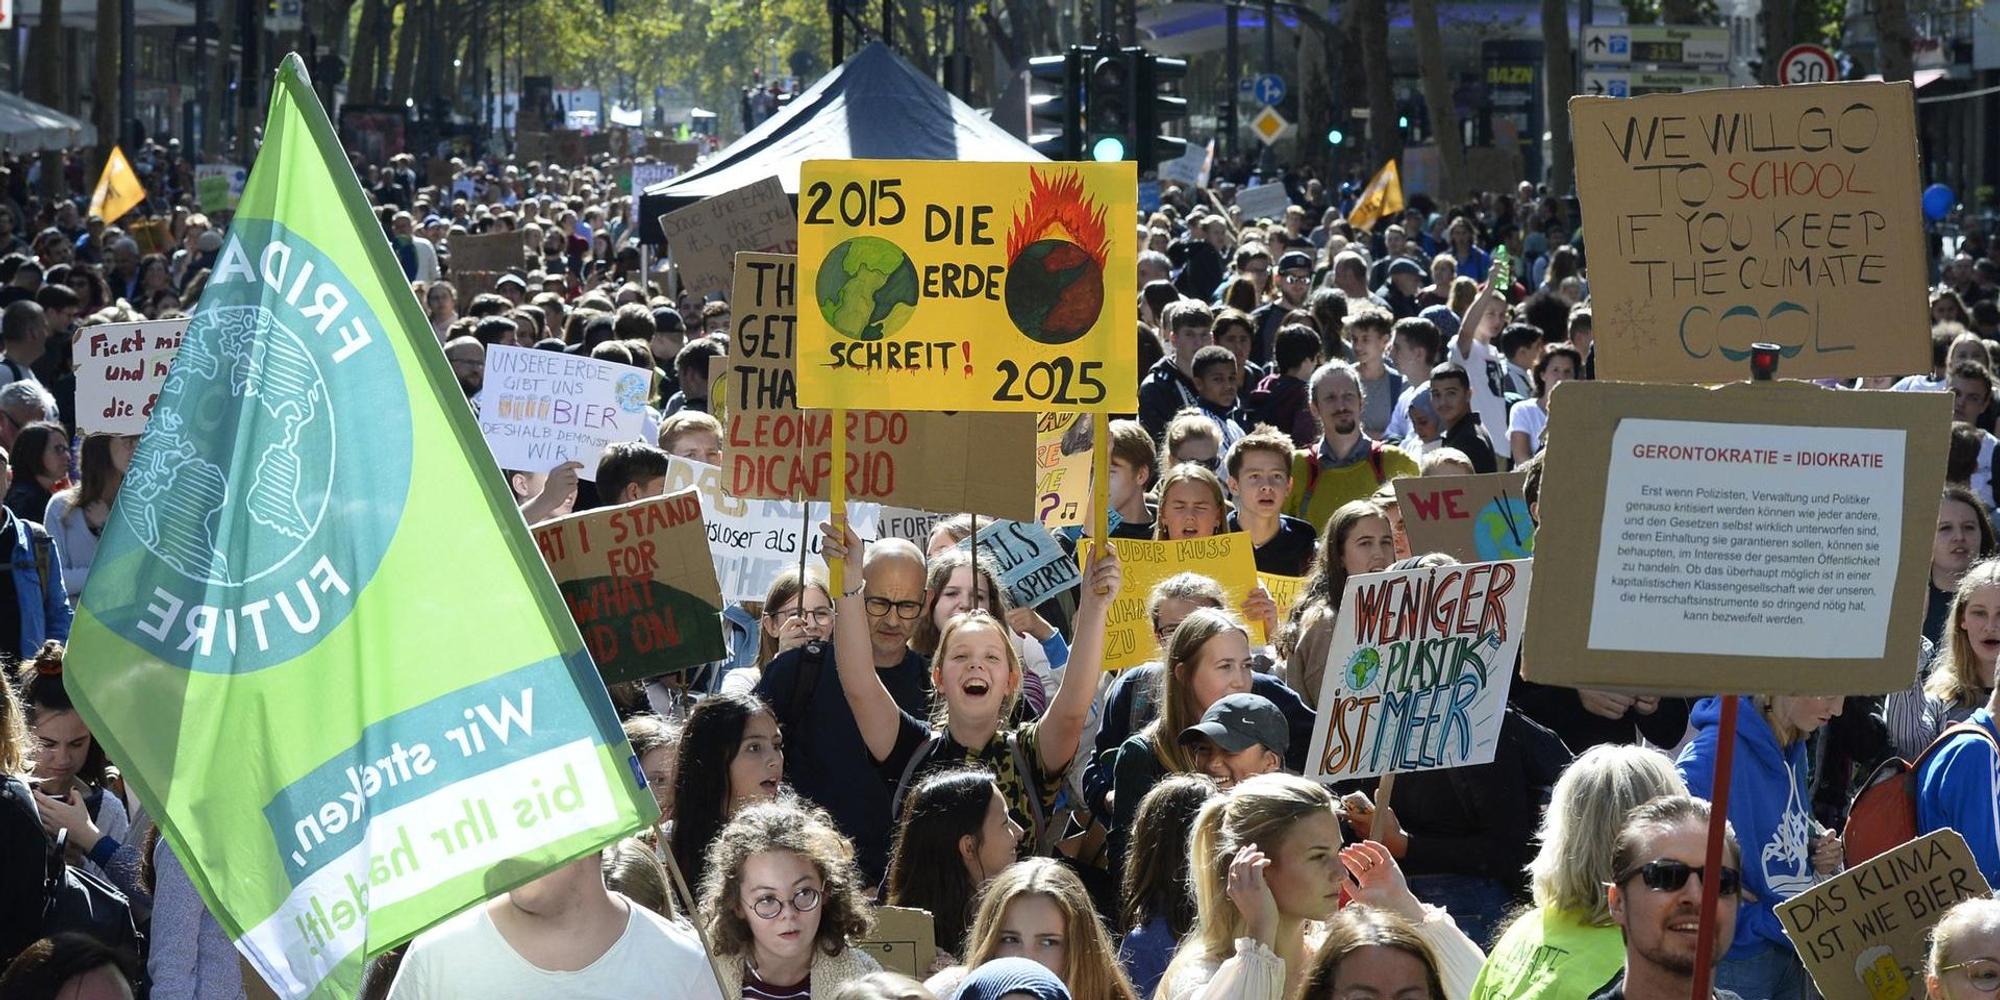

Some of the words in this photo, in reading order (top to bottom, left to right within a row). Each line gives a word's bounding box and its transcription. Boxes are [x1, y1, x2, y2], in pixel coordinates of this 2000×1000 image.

[1791, 60, 1824, 83] 30
[1602, 116, 1690, 163] WE
[1698, 112, 1796, 155] WILL
[1798, 103, 1880, 153] GO
[1633, 162, 1715, 209] TO
[1727, 160, 1877, 200] SCHOOL
[804, 178, 906, 227] 2015
[925, 204, 995, 246] DIE
[1616, 213, 1663, 257] IF
[1675, 211, 1751, 255] YOU
[1772, 210, 1887, 250] KEEP
[746, 262, 796, 308] TH
[923, 263, 1005, 301] ERDE
[1629, 258, 1729, 298] THE
[1738, 254, 1888, 290] CLIMATE
[90, 329, 146, 357] Fickt
[738, 314, 798, 359] GET
[1679, 299, 1856, 361] COOL
[105, 358, 145, 381] und
[492, 351, 561, 376] UNSERE
[563, 359, 615, 381] ERDE
[821, 340, 974, 377] SCHREIT!
[503, 377, 547, 393] GIBT
[552, 381, 585, 397] UNS
[992, 356, 1107, 405] 2025
[103, 396, 135, 418] die
[553, 399, 619, 430] BIER
[482, 422, 552, 439] DESHALB
[1633, 443, 1779, 465] GERONTOKRATIE
[1797, 451, 1884, 469] IDIOKRATIE
[732, 450, 896, 498] DICAPRIO
[1407, 489, 1470, 521] WE
[1625, 501, 1671, 513] genauso
[1673, 502, 1714, 514] kritisiert
[1716, 504, 1755, 516] werden
[1758, 505, 1796, 518] können
[1798, 509, 1815, 519] wie
[1817, 509, 1842, 521] jeder
[1641, 484, 1663, 497] Erst
[1665, 487, 1693, 498] wenn
[1752, 490, 1809, 506] Verwaltung
[1811, 493, 1830, 504] und
[1832, 493, 1871, 505] Politiker
[578, 519, 591, 554] I
[609, 495, 702, 544] STAND
[764, 528, 797, 553] als
[1621, 530, 1652, 541] deren
[1655, 532, 1710, 546] Einhaltung
[1712, 534, 1728, 545] sie
[1730, 536, 1789, 549] garantieren
[1827, 540, 1863, 552] können
[1865, 541, 1880, 551] sie
[1624, 516, 1644, 526] und
[1646, 516, 1667, 527] den
[1669, 517, 1719, 529] Gesetzen
[1722, 520, 1753, 531] selbst
[1755, 522, 1793, 533] wirklich
[1796, 524, 1854, 537] unterworfen
[607, 539, 660, 577] FOR
[1175, 537, 1233, 562] MUSS
[1679, 548, 1692, 558] im
[1694, 549, 1742, 561] Interesse
[1744, 552, 1762, 563] der
[1764, 553, 1815, 566] gesamten
[1817, 553, 1881, 567] Öffentlichkeit
[1016, 555, 1082, 602] SPIRIT
[1611, 576, 1691, 589] kapitalistischen
[1694, 579, 1796, 595] Klassengesellschaft
[1798, 586, 1815, 595] wie
[1817, 584, 1834, 595] der
[1622, 562, 1635, 572] zu
[1685, 563, 1702, 575] Ob
[1704, 565, 1724, 576] das
[1727, 566, 1778, 579] überhaupt
[1780, 569, 1820, 582] möglich
[1822, 571, 1834, 580] ist
[1835, 572, 1845, 580] in
[1847, 571, 1871, 581] einer
[566, 572, 656, 625] WHAT
[1620, 591, 1636, 602] die
[1639, 592, 1759, 608] Herrschaftsinstrumente
[1762, 600, 1774, 609] so
[1777, 599, 1820, 612] dringend
[1822, 600, 1847, 613] nötig
[631, 605, 683, 654] ON
[1683, 610, 1709, 621] kann
[1711, 611, 1763, 624] bezweifelt
[1105, 629, 1137, 660] ZU
[1384, 629, 1498, 694] PLASTIK
[1369, 673, 1481, 772] MEER
[1788, 884, 1848, 934] DAS
[1852, 839, 1953, 900] KLIMA
[1806, 925, 1846, 964] IST
[1852, 902, 1900, 942] WIE
[1903, 867, 1976, 920] BIER
